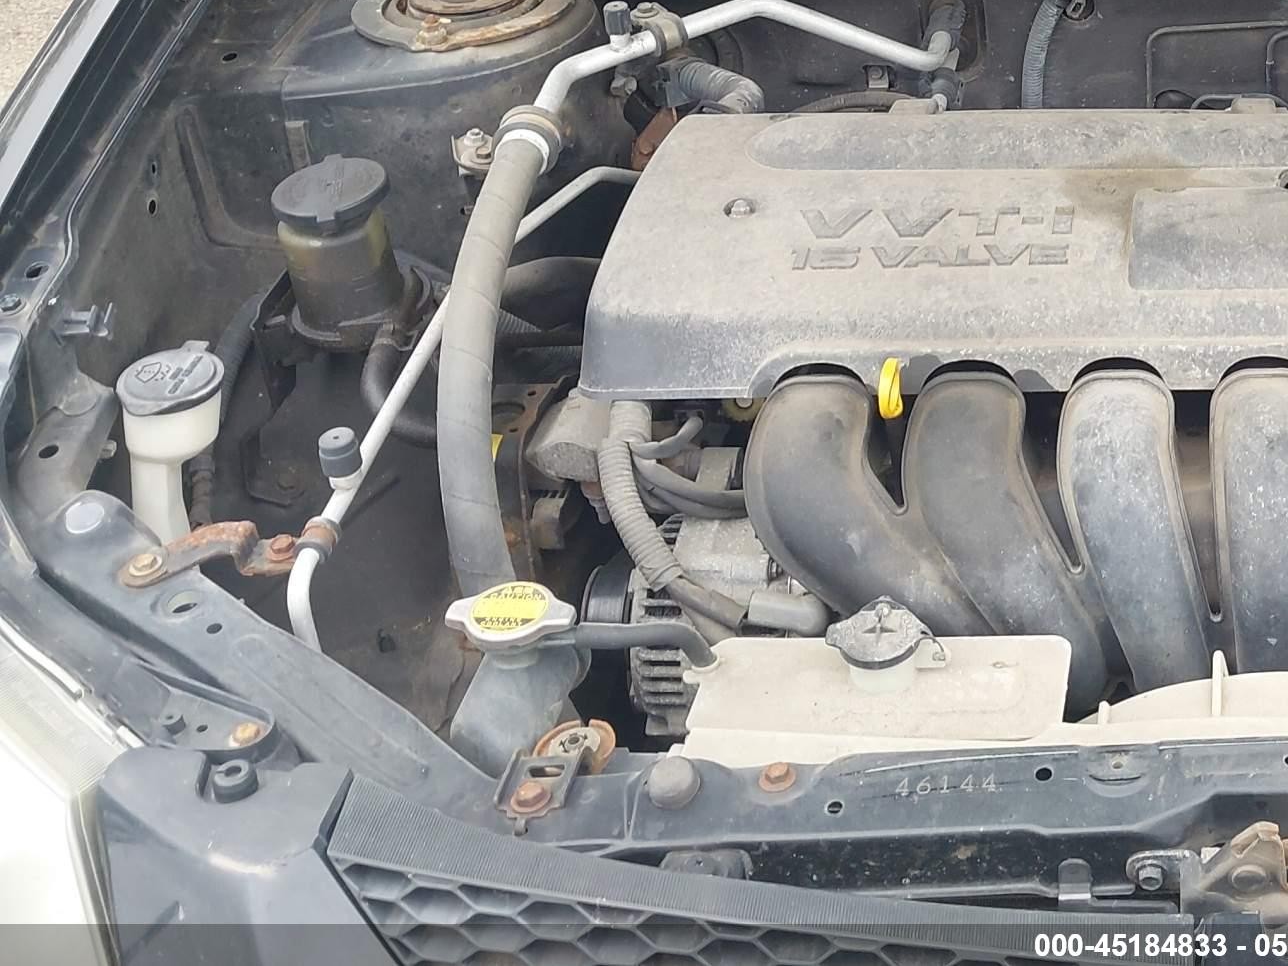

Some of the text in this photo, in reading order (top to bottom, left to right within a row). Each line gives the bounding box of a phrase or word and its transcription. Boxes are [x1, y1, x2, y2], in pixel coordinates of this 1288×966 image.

[791, 243, 1070, 271] 16 VALVE
[895, 773, 998, 796] 46144
